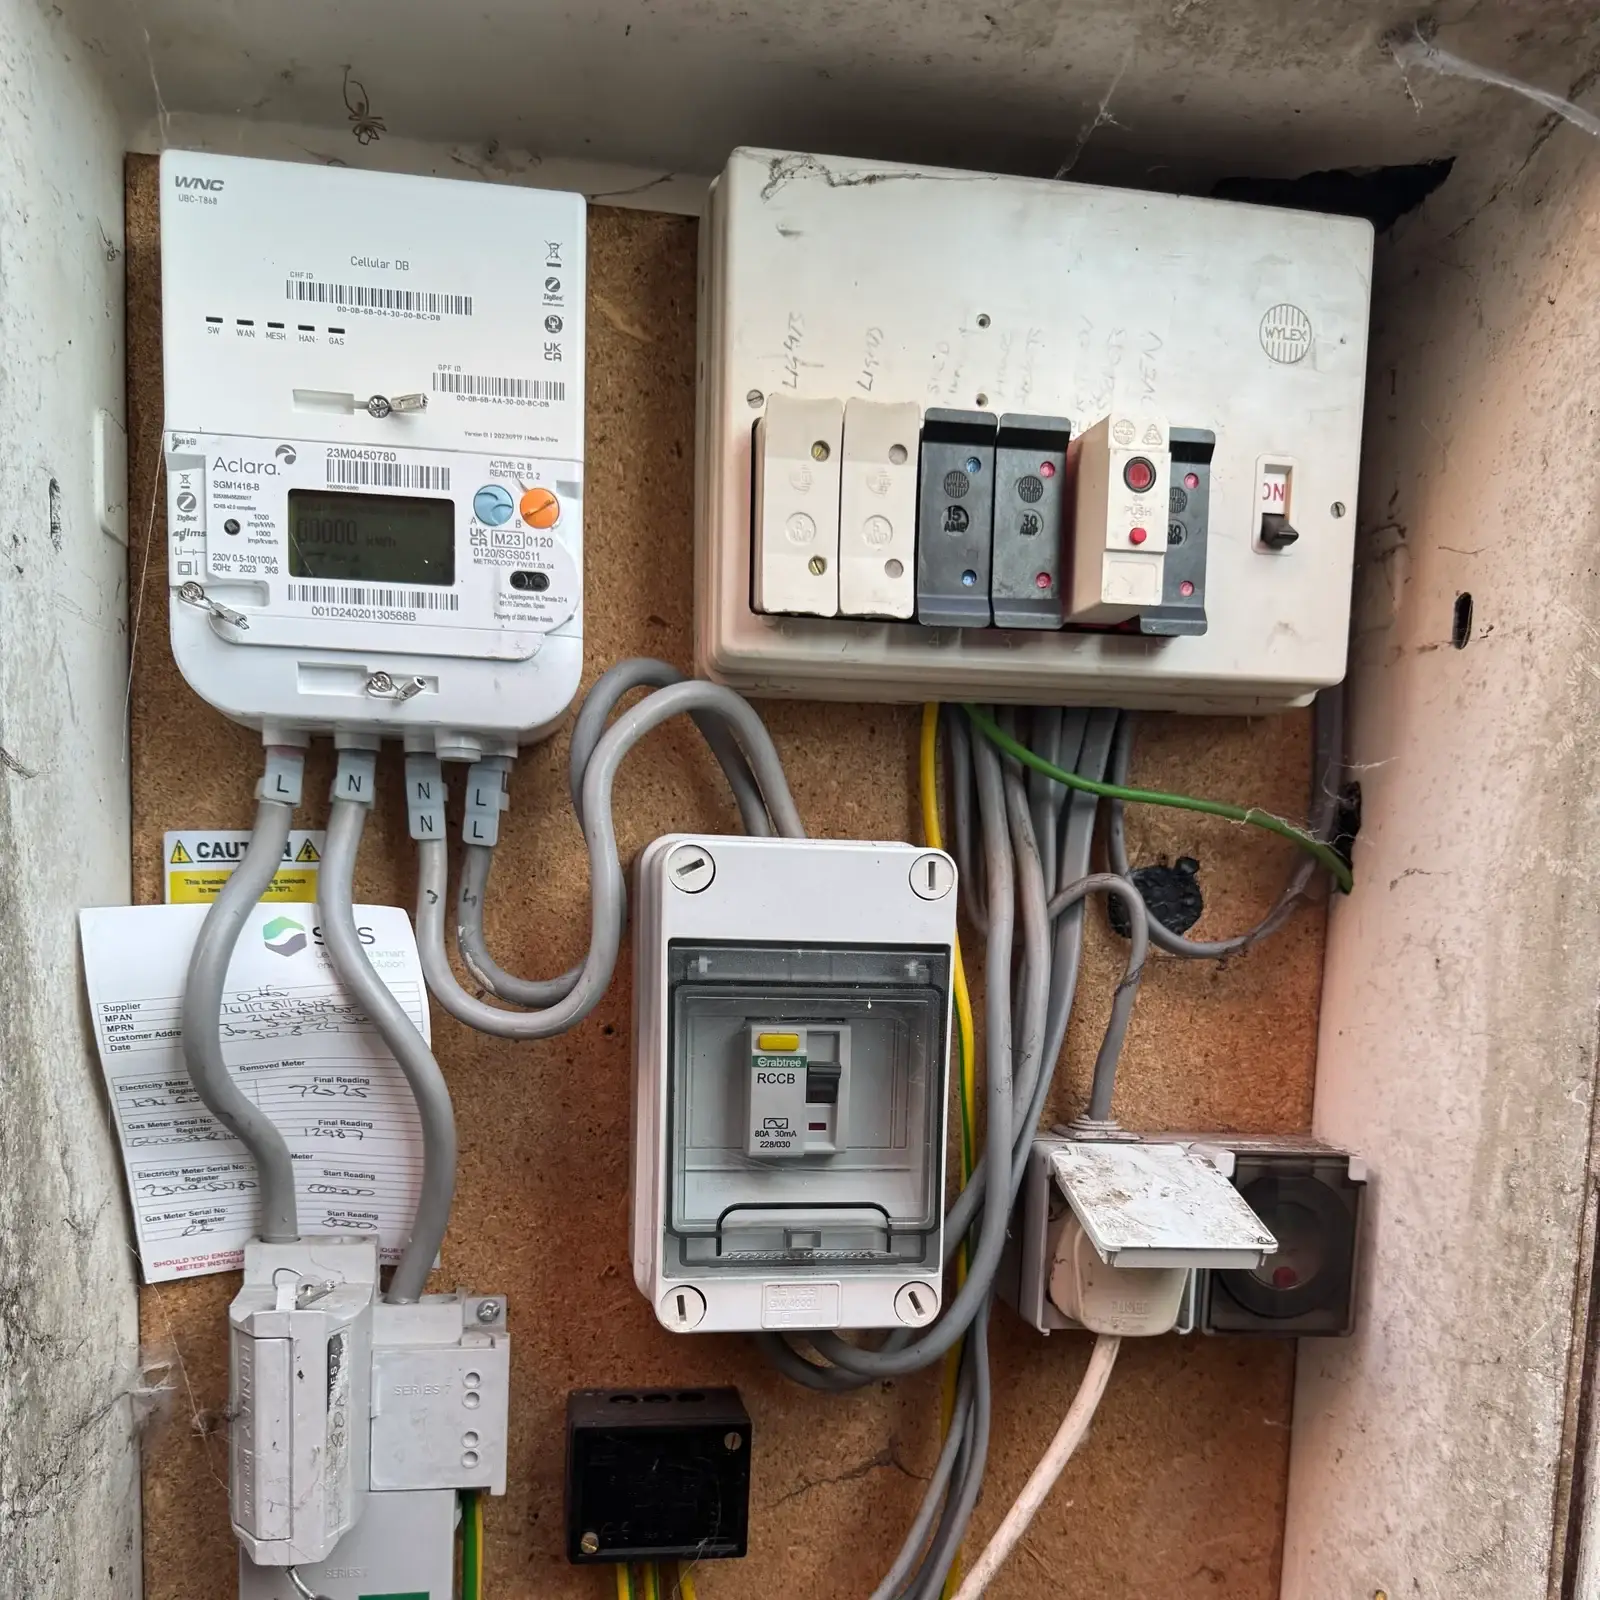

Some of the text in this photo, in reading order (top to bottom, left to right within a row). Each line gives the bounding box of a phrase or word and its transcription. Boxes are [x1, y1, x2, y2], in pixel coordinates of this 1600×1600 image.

[175, 175, 225, 192] WNC
[178, 194, 218, 205] UBC-T868
[350, 255, 410, 271] Cellular DB
[289, 270, 314, 280] CHF ID
[207, 326, 220, 335] SW
[236, 328, 256, 338] WAN
[265, 331, 287, 341] MESH
[1264, 326, 1307, 342] WYLEX
[298, 334, 316, 344] HAN
[328, 336, 345, 346] GAS
[326, 447, 397, 462] 23M0450780
[212, 480, 260, 491] SGM1416-B
[1262, 482, 1285, 502] ON
[253, 513, 270, 521] 1000
[1023, 514, 1038, 527] 30
[515, 519, 522, 528] B
[255, 530, 271, 538] 1000
[469, 527, 488, 538] UK
[469, 537, 488, 547] CA
[493, 533, 554, 548] M23 0120
[232, 554, 279, 565] 0.5-10(100)A
[473, 547, 541, 562] 0120/SGS0511
[212, 563, 232, 572] 50Hz
[239, 565, 257, 573] 2023
[473, 558, 515, 568] METROLOGY
[311, 605, 417, 622] 001D24020130568B
[276, 774, 290, 793] L
[348, 774, 362, 793] N
[418, 781, 431, 800] N
[475, 788, 487, 807] L
[420, 814, 433, 832] N
[472, 820, 484, 839] L
[103, 1002, 141, 1013] Supplier
[105, 1013, 133, 1023] MPAN
[106, 1024, 135, 1033] MPRN
[108, 1031, 153, 1043] Customer
[110, 1044, 131, 1052] Date
[239, 1059, 306, 1072] Removed Meter
[757, 1056, 802, 1068] Crabtree
[336, 1077, 370, 1085] Reading
[756, 1072, 796, 1085] RCCB
[119, 1080, 189, 1092] Electricity Meter
[147, 1121, 171, 1129] Meter
[173, 1118, 198, 1126] Serial
[339, 1119, 373, 1129] Reading
[176, 1126, 212, 1135] Register
[754, 1129, 798, 1138] 80A 30mA
[759, 1140, 791, 1149] 228/030
[137, 1170, 180, 1179] Electricity
[207, 1165, 231, 1173] Serial
[323, 1169, 376, 1180] Start Reading
[184, 1175, 220, 1184] Register
[145, 1215, 162, 1223] Gas
[163, 1212, 187, 1220] Meter
[188, 1208, 212, 1217] Serial
[191, 1216, 227, 1225] Register
[347, 1211, 379, 1220] Reading
[153, 1254, 210, 1268] SHOULD YOU
[176, 1263, 206, 1272] METER
[393, 1384, 441, 1397] SERIES
